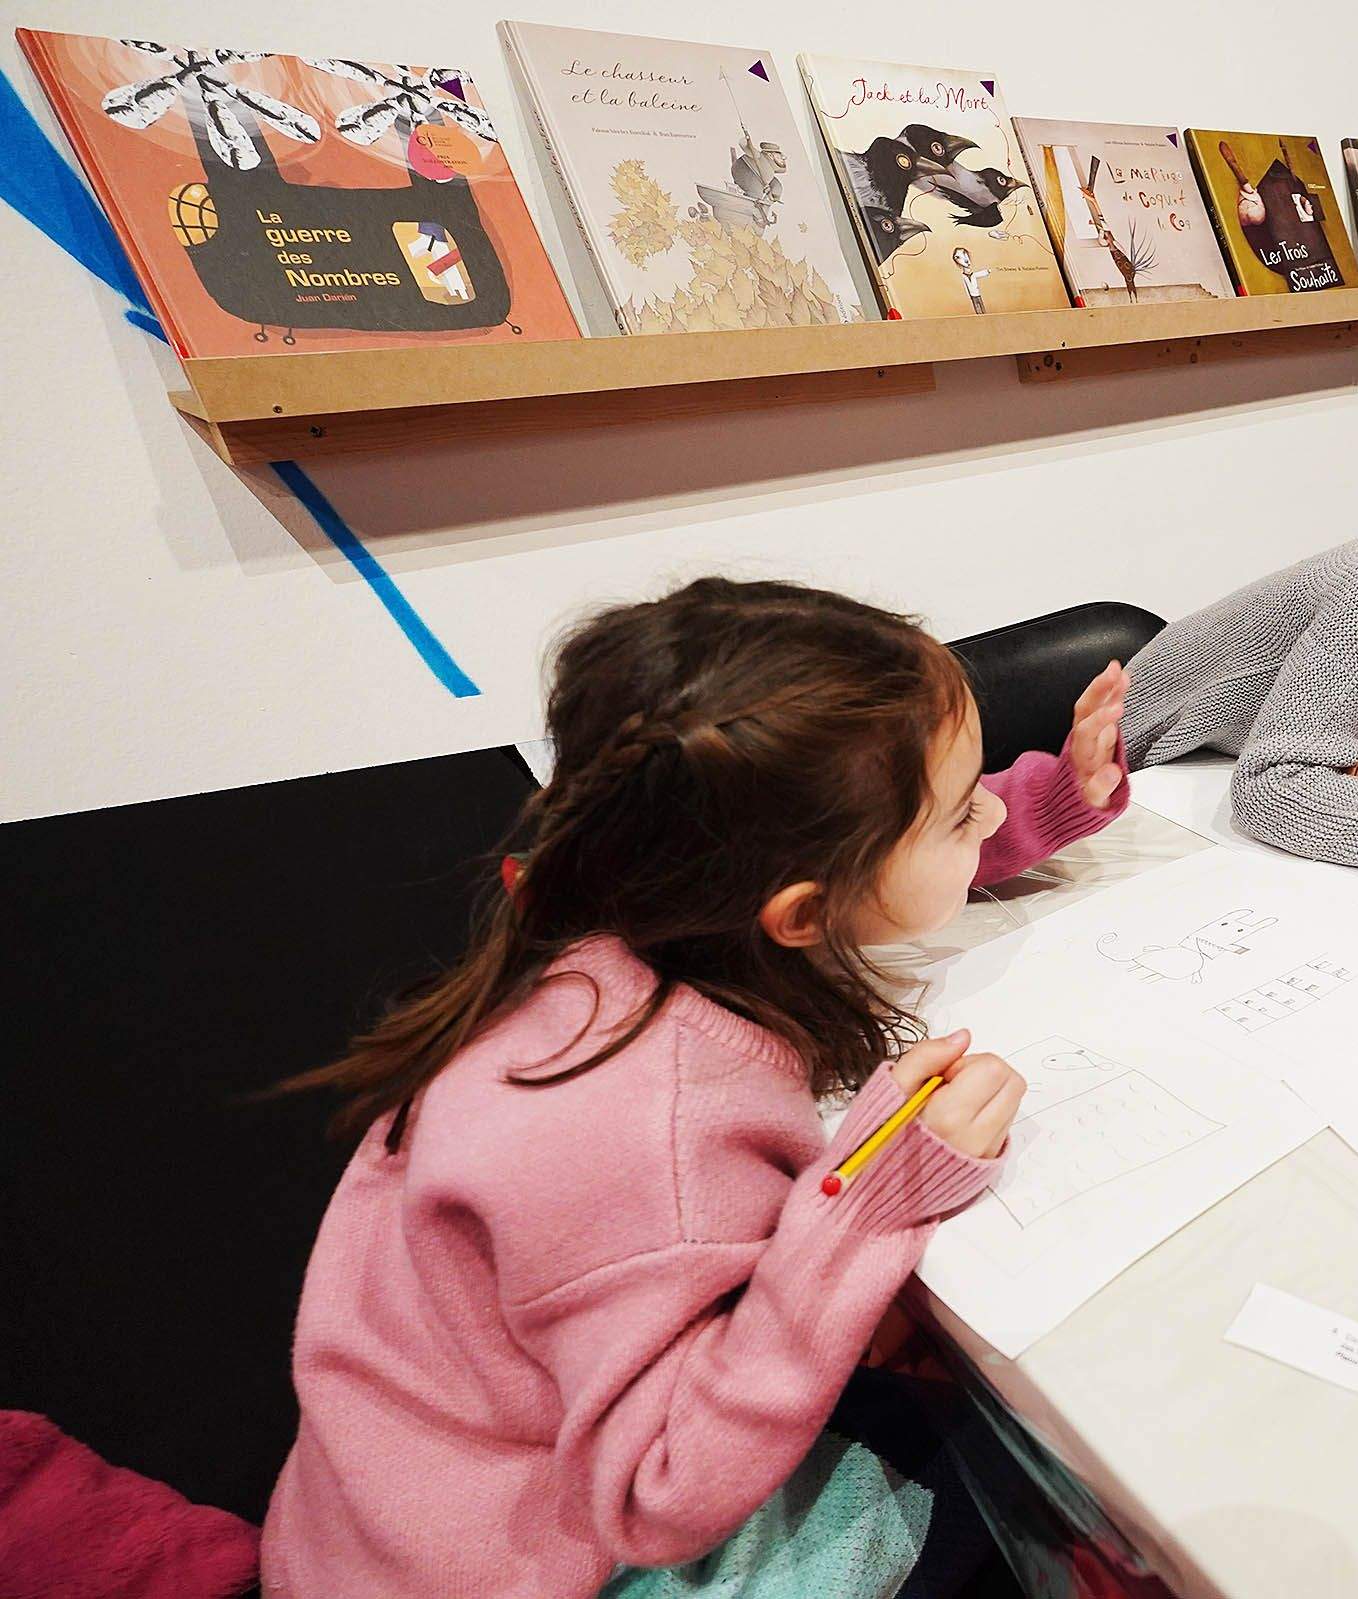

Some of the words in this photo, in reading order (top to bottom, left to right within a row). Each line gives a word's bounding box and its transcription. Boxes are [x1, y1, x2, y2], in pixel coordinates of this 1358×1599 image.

[561, 59, 597, 76] Le
[601, 62, 695, 86] chasseur
[571, 88, 596, 104] et
[600, 88, 623, 106] la
[628, 91, 703, 113] baleine
[851, 78, 894, 106] Jack
[900, 90, 914, 103] et
[919, 88, 936, 104] la
[936, 82, 989, 112] Mort
[256, 209, 282, 224] La
[265, 228, 352, 248] guerre
[277, 250, 313, 265] des
[1260, 248, 1281, 266] Les
[1278, 241, 1308, 261] Trois
[284, 268, 401, 287] Nombres
[1289, 263, 1338, 291] Souhaits
[296, 293, 321, 303] Juan
